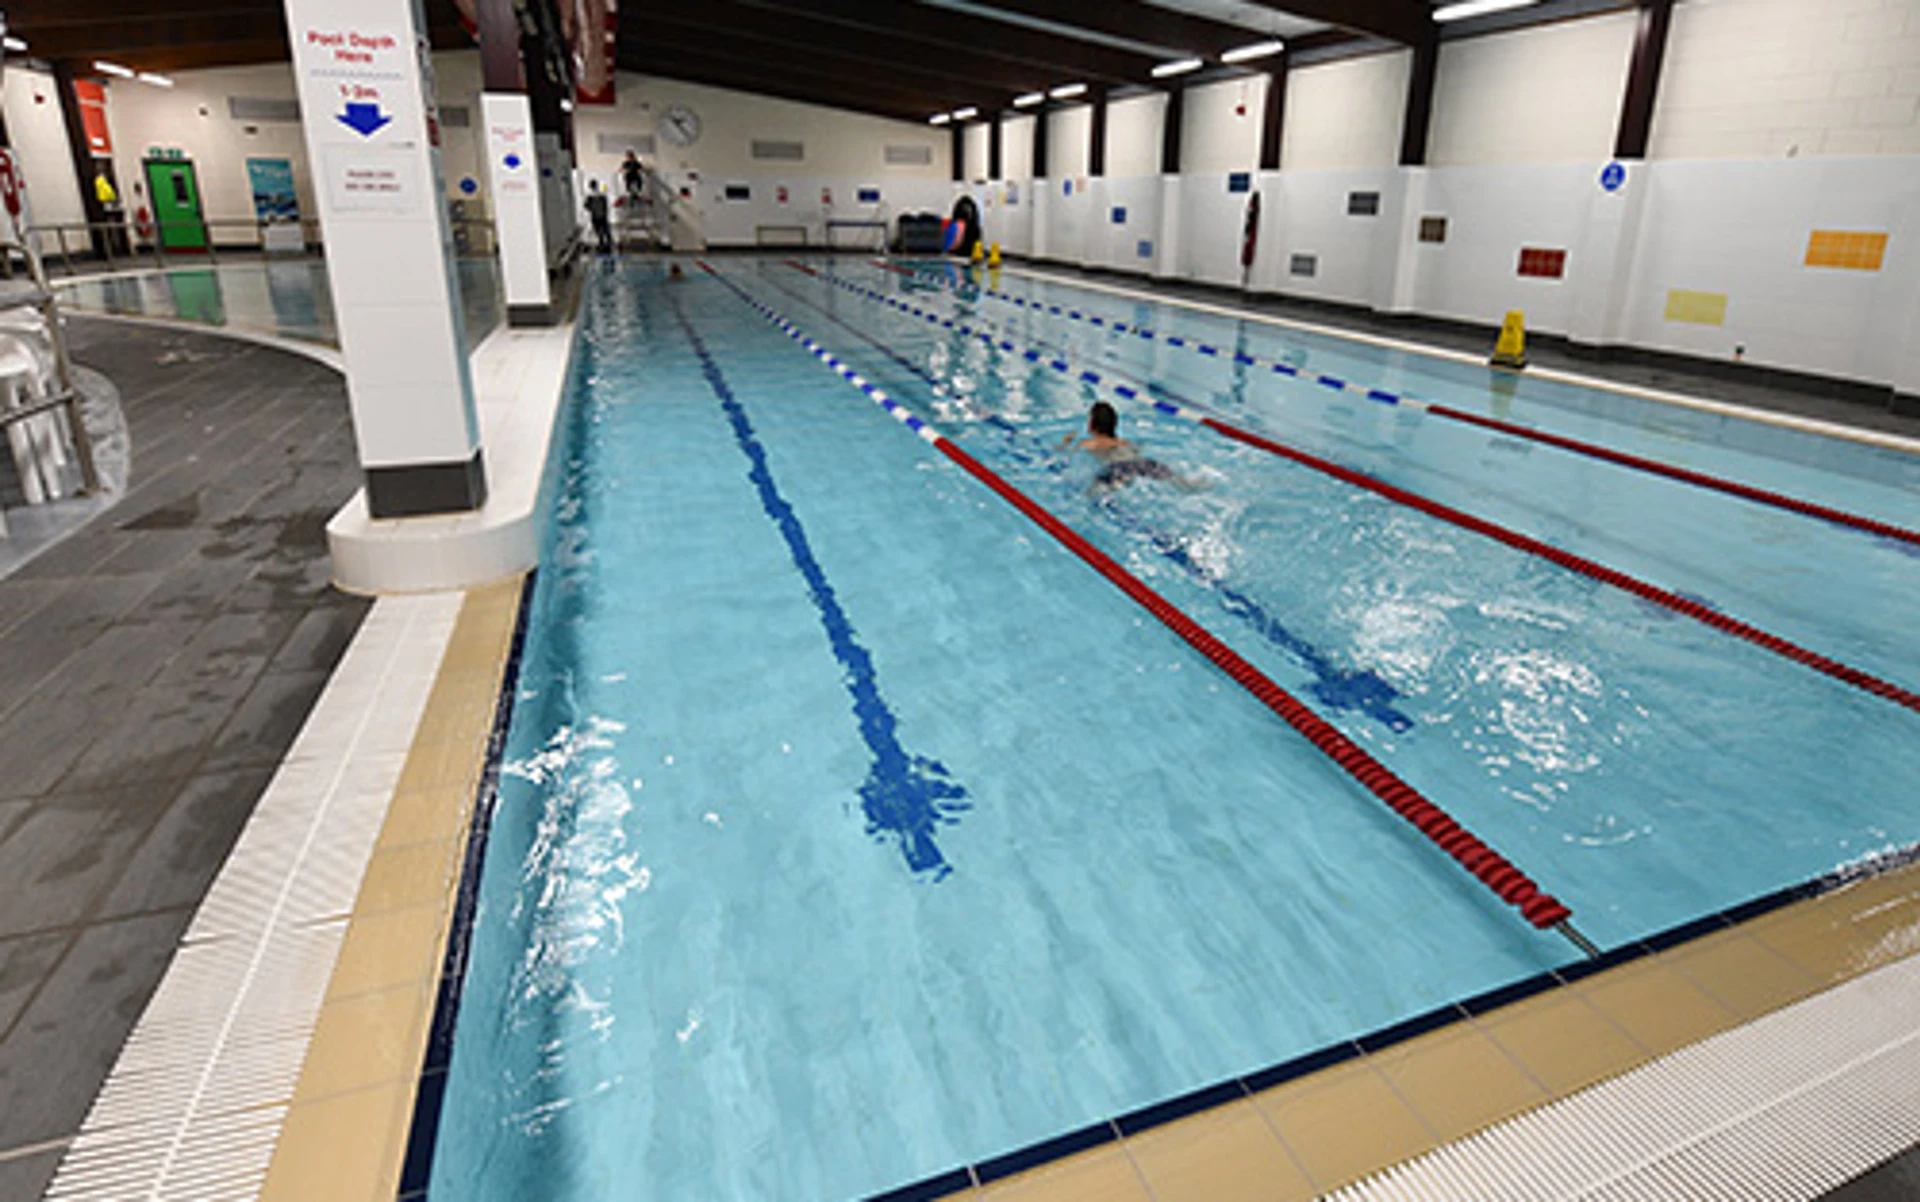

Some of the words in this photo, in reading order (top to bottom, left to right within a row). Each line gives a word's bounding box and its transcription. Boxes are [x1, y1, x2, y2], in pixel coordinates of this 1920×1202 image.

[307, 30, 343, 47] Pool
[349, 32, 396, 50] Depth
[335, 50, 373, 63] Here
